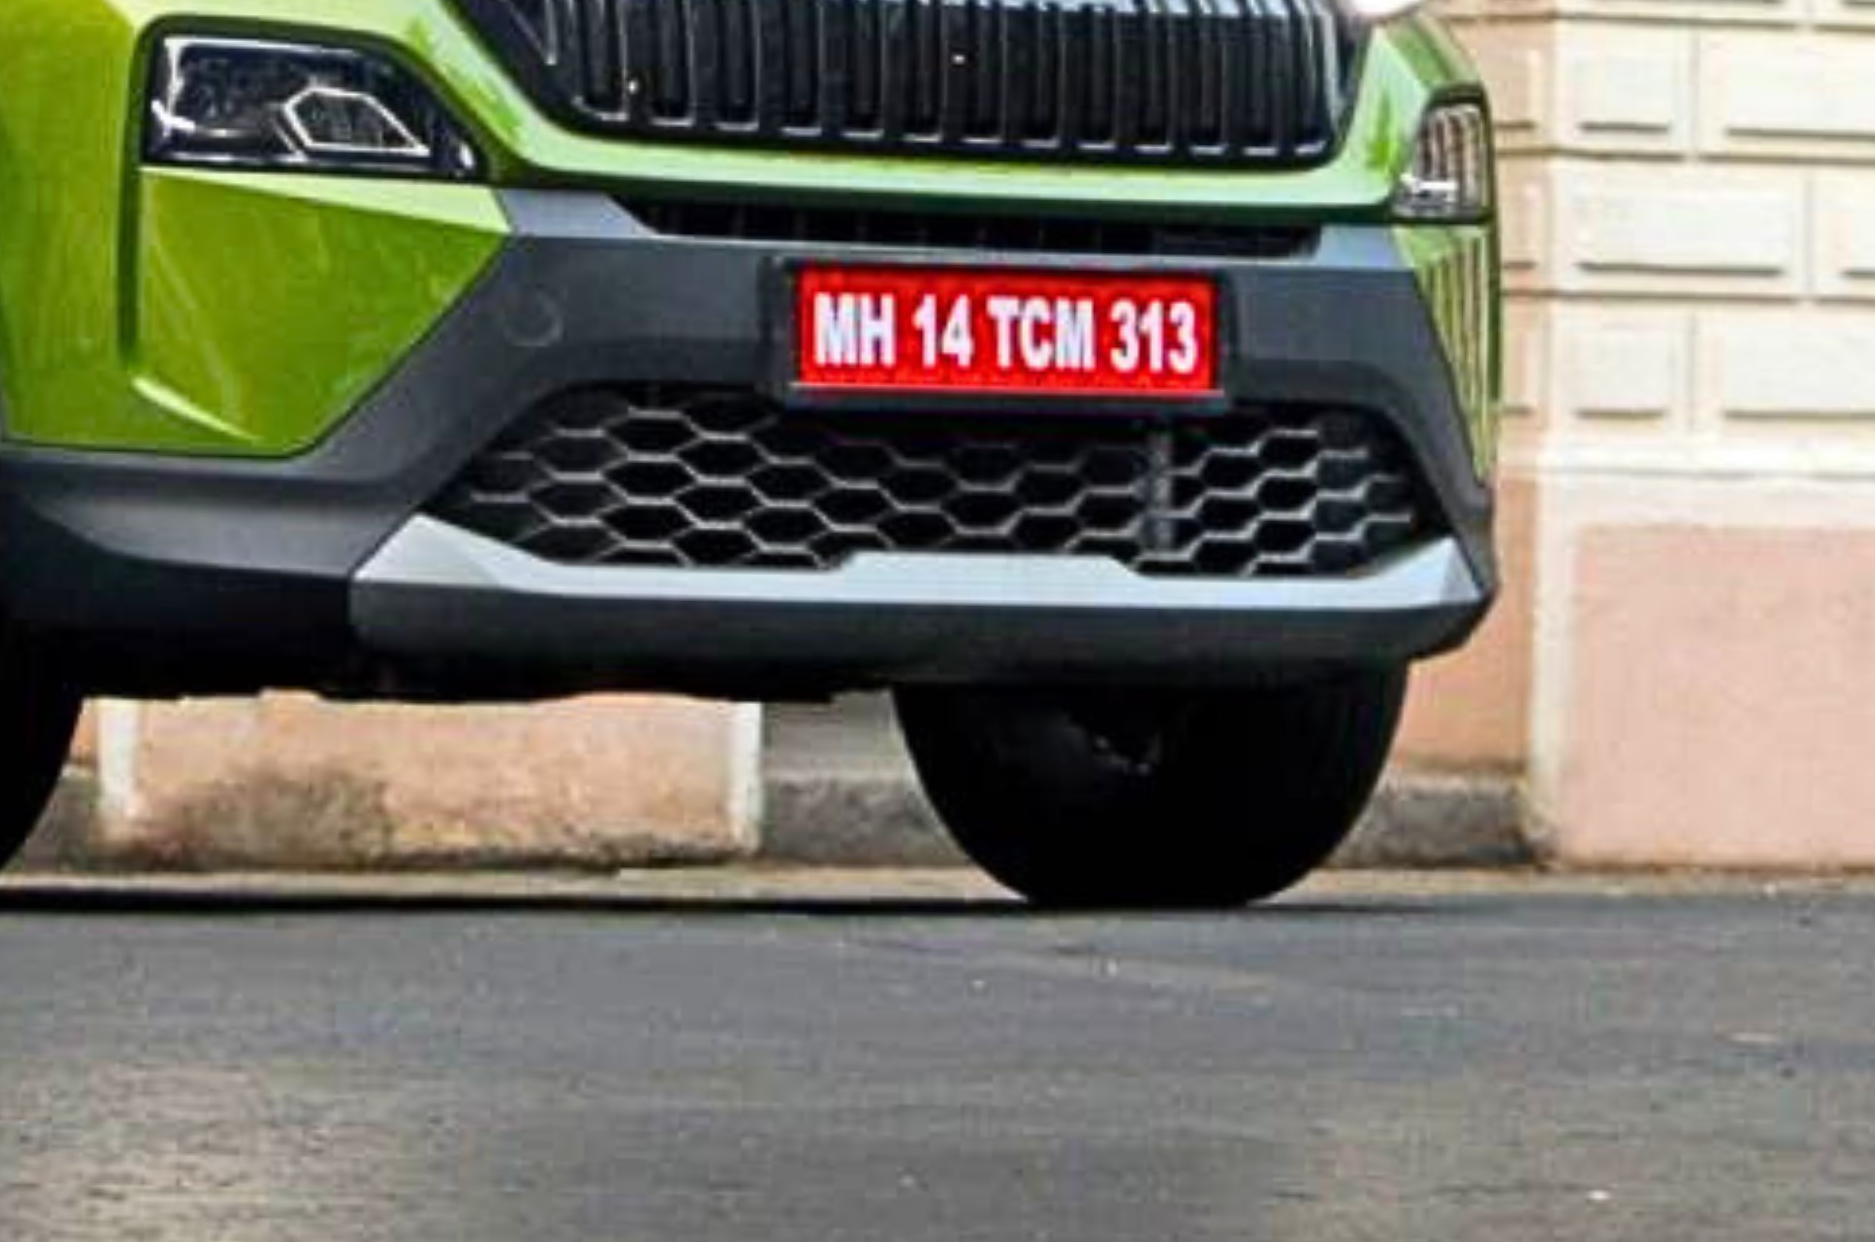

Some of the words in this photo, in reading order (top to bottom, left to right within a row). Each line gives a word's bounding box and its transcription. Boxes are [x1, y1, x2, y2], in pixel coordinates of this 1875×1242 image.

[814, 292, 896, 366] MH
[914, 294, 974, 368] 14
[987, 296, 1095, 371] TCM
[1110, 299, 1198, 373] 313
